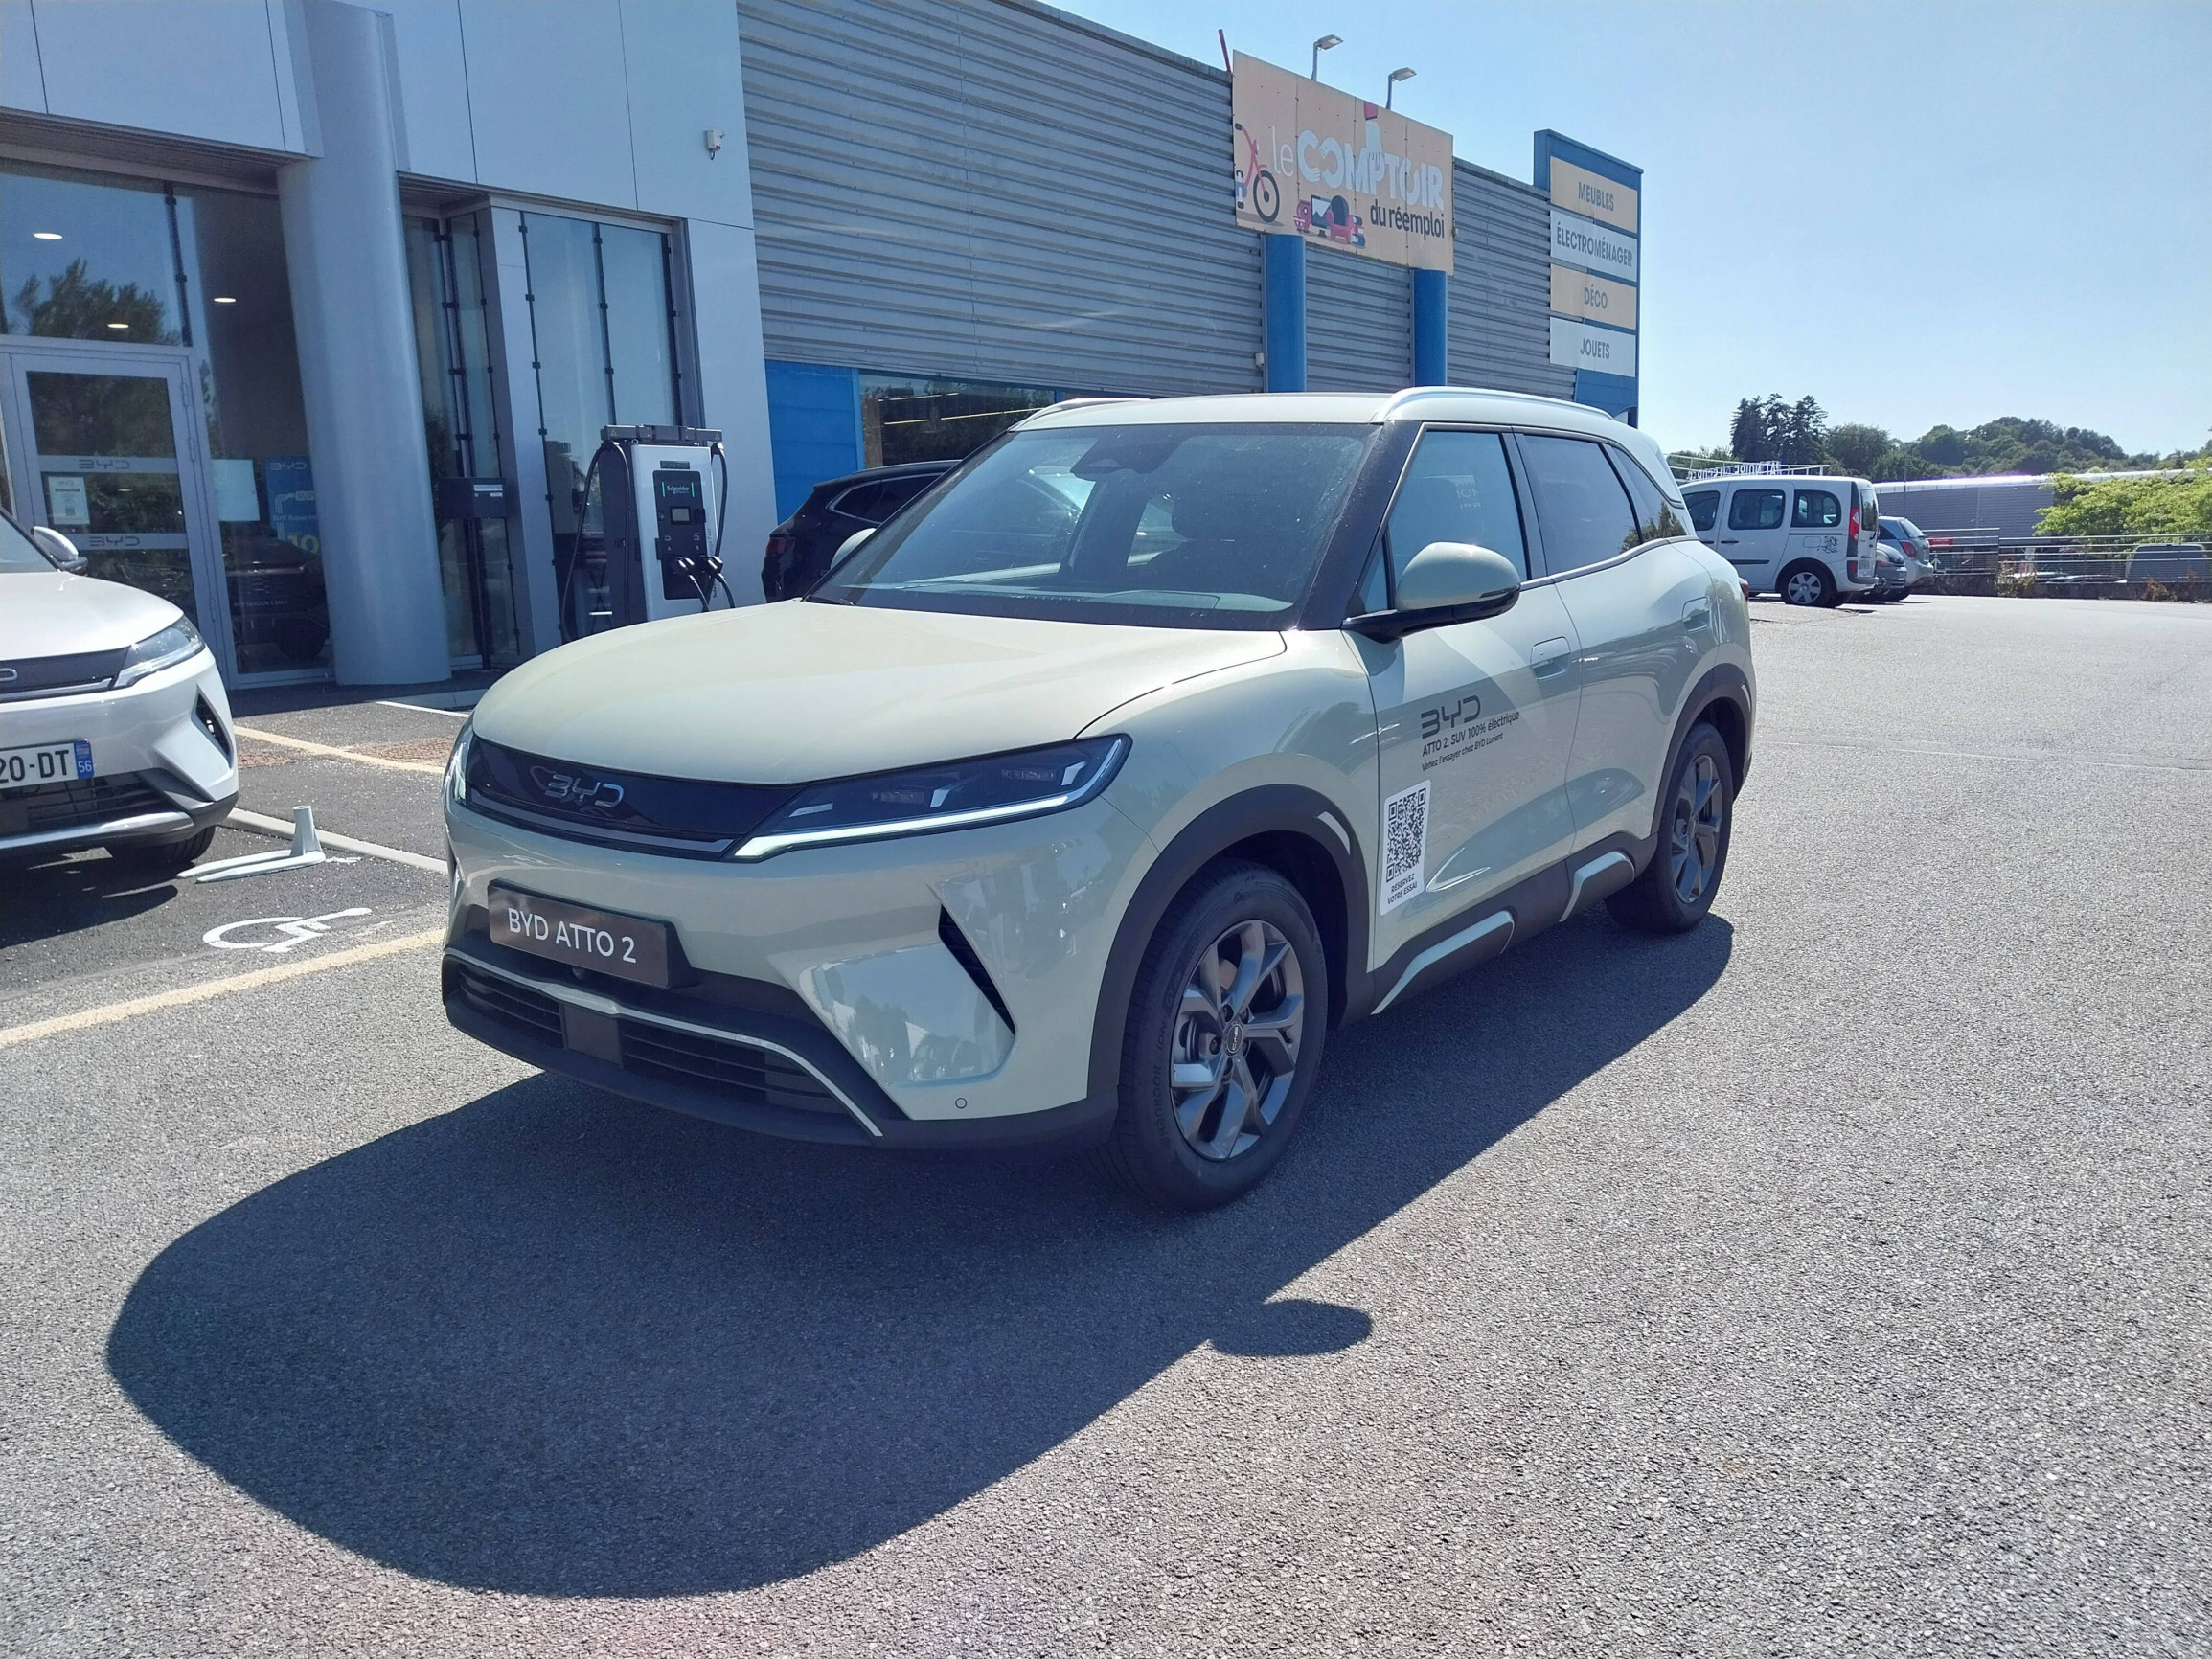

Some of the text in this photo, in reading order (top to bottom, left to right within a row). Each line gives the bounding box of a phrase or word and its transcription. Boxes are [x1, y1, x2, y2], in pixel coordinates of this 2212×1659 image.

[1272, 125, 1294, 177] le
[1578, 181, 1614, 212] MEUBLES
[1370, 199, 1445, 241] du réemploi
[1556, 221, 1633, 267] ÉLECTROMÉNAGER
[1584, 284, 1608, 309] DÉCO
[1580, 337, 1610, 360] JOUETS
[78, 459, 130, 470] BYD
[89, 536, 141, 547] BYD
[1421, 694, 1481, 739] BYD
[1422, 739, 1442, 757] ATTO
[1450, 729, 1466, 745] SUV
[1467, 722, 1487, 739] 100%
[1487, 711, 1520, 732] électrique
[77, 760, 93, 773] 56
[1422, 759, 1439, 771] Venez
[1461, 744, 1474, 756] chez
[1474, 739, 1486, 750] BYD
[1486, 732, 1504, 745] Lorient
[544, 773, 624, 807] BYD
[508, 907, 637, 964] BYD ATTO 2
